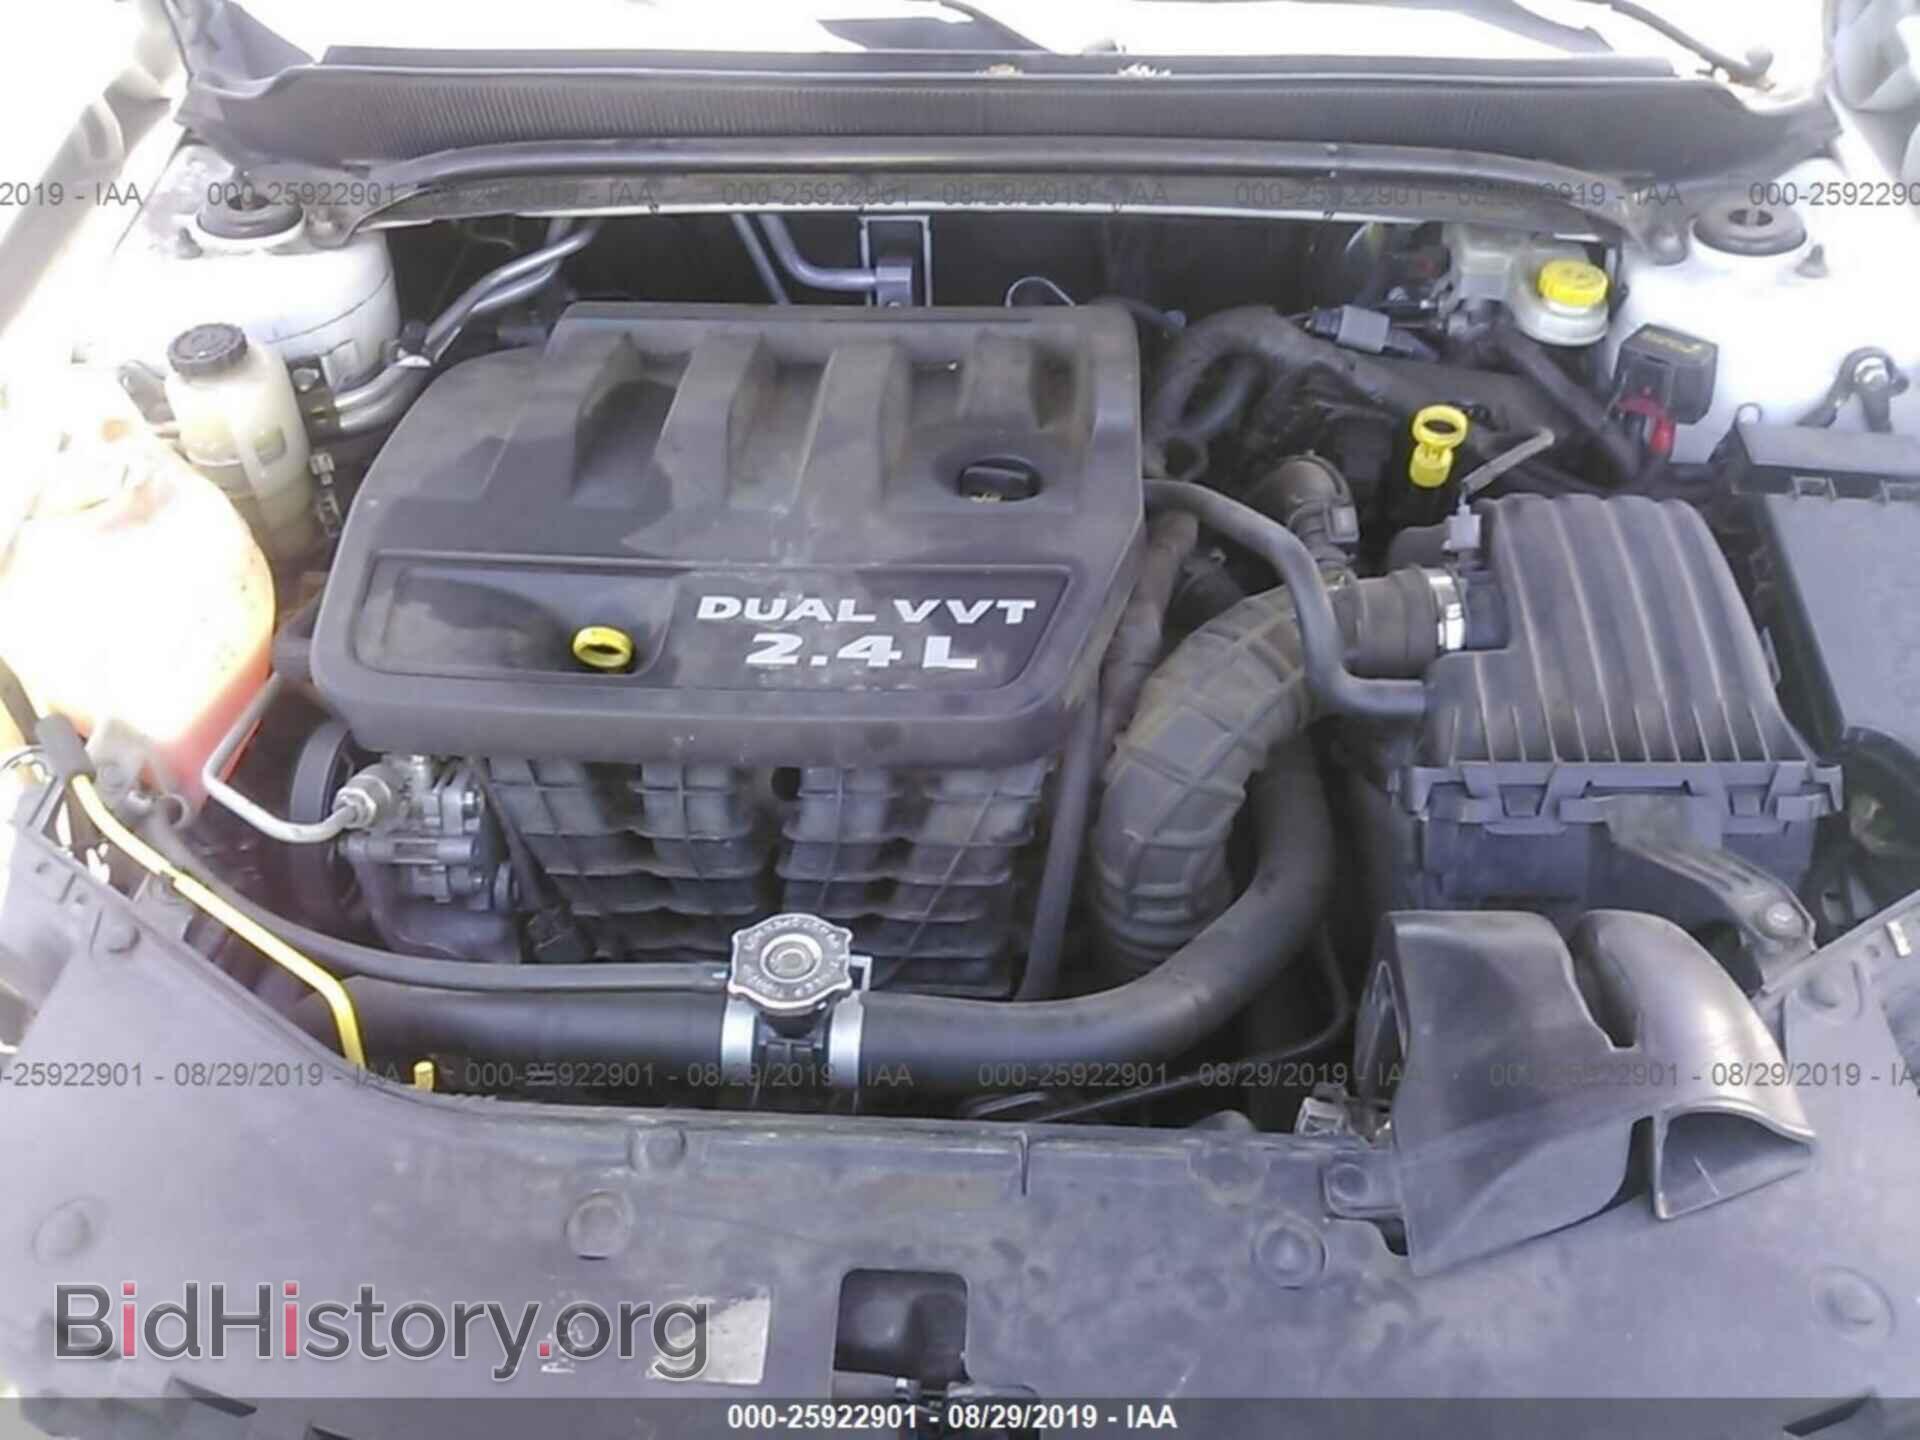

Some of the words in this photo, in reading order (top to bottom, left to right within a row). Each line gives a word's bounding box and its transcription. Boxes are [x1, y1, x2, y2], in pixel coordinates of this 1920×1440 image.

[696, 594, 876, 623] DUAL
[893, 598, 1037, 625] VVT
[744, 633, 902, 668] 2.4
